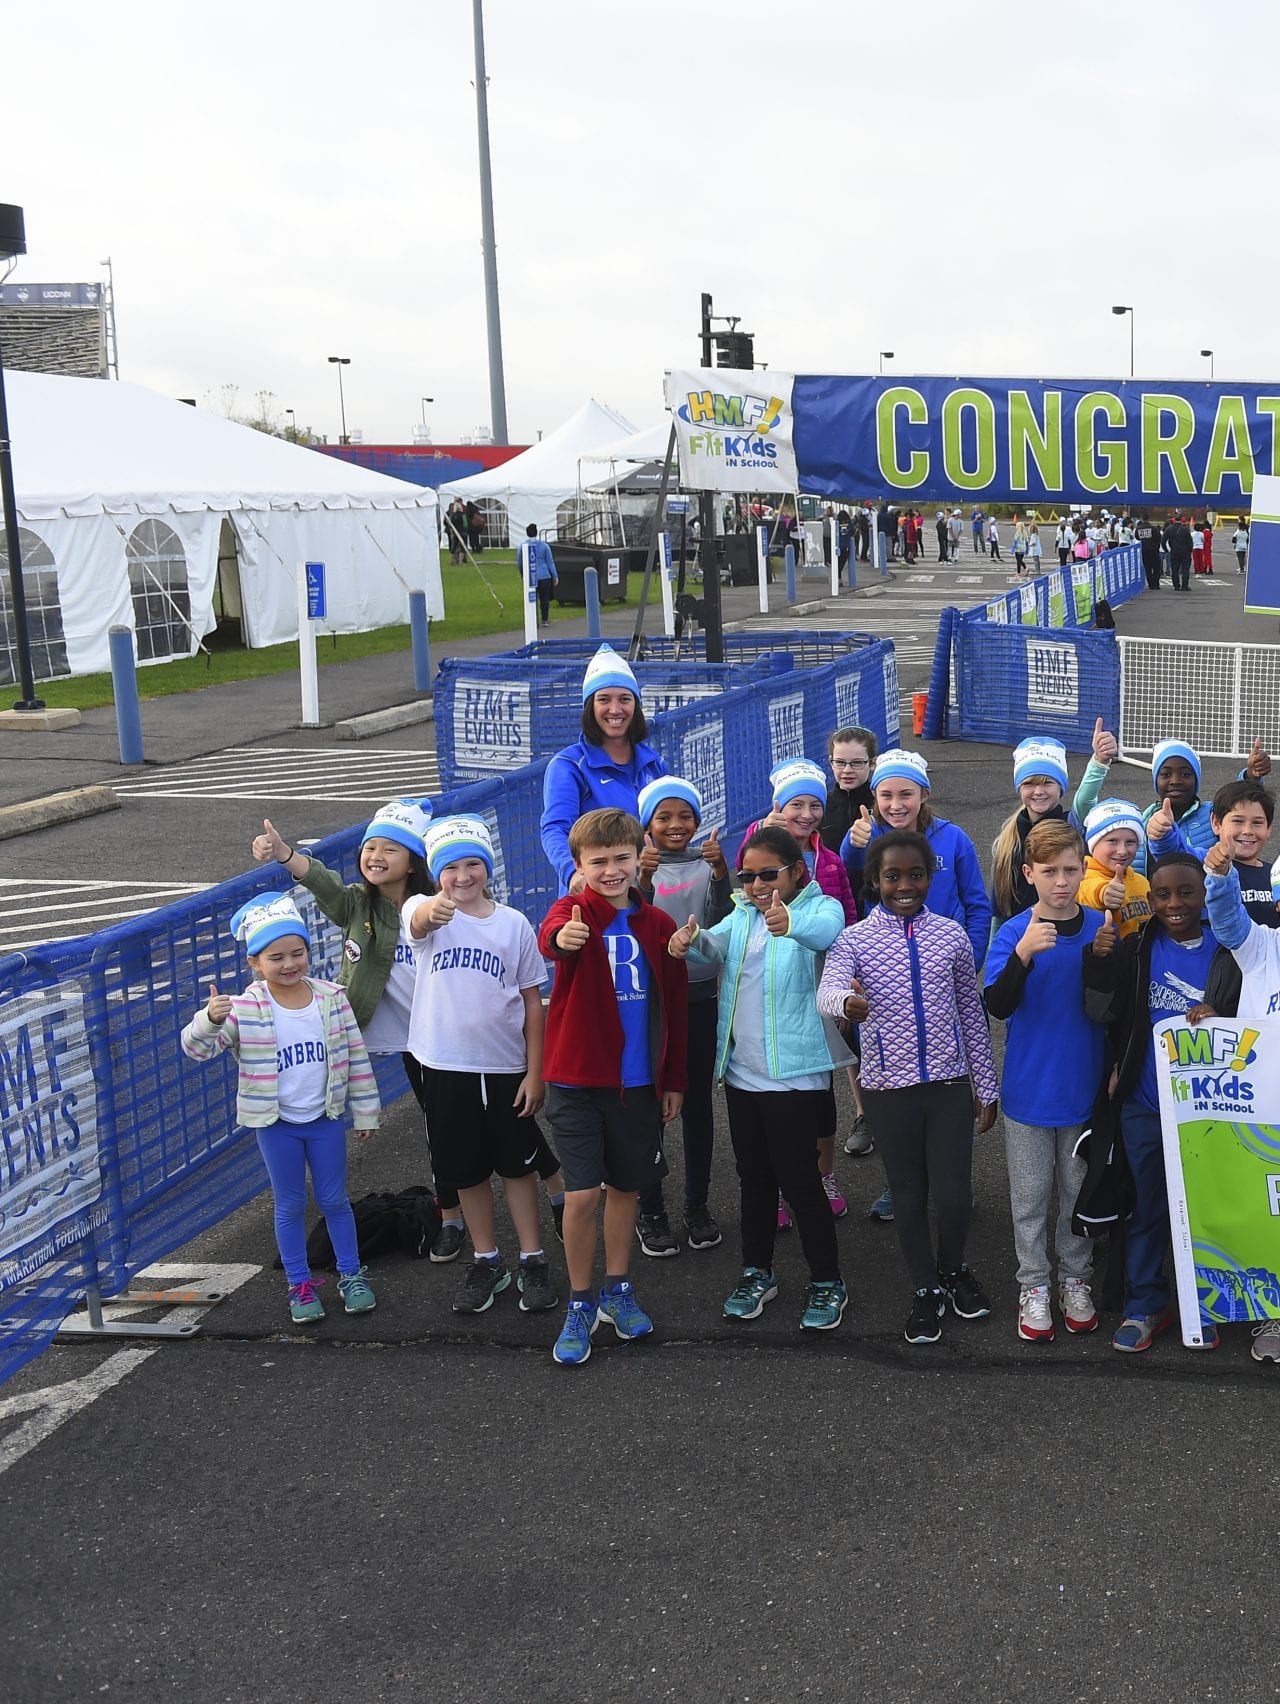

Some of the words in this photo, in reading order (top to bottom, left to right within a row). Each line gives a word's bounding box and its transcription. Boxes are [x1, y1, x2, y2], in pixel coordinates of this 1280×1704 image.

[42, 290, 72, 298] UCONN
[686, 390, 785, 435] HMF!
[1034, 648, 1072, 676] HMF
[1035, 674, 1073, 697] EVENTS
[464, 688, 521, 721] HMF
[464, 721, 522, 747] EVENTS
[1240, 889, 1275, 903] RENBR
[602, 934, 647, 994] R
[0, 1009, 68, 1120] MF
[0, 1092, 81, 1188] ENTS
[6, 1237, 56, 1286] MARATHON
[55, 1205, 109, 1253] FOUNDATION
